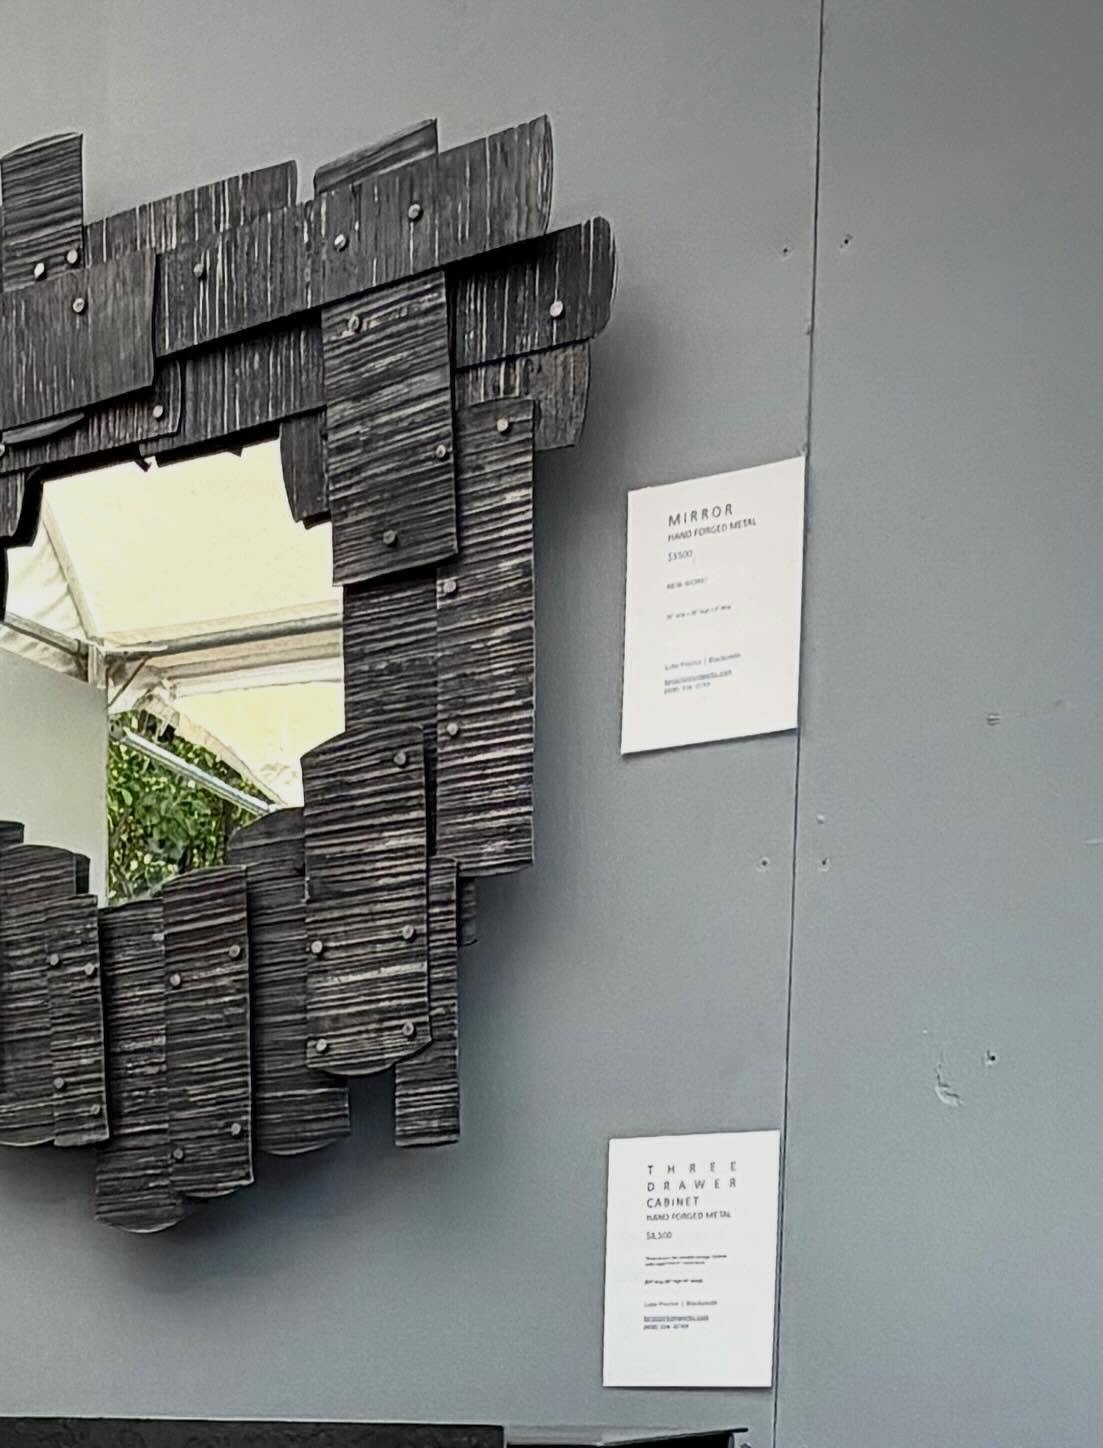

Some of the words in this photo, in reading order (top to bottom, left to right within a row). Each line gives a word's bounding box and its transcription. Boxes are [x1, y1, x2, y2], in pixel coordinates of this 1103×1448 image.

[668, 503, 733, 527] MIRROR
[694, 523, 728, 537] FORGED
[729, 518, 757, 529] METAL
[647, 1161, 737, 1175] THREE
[646, 1177, 737, 1192] DRAWER
[646, 1196, 699, 1209] CABINET
